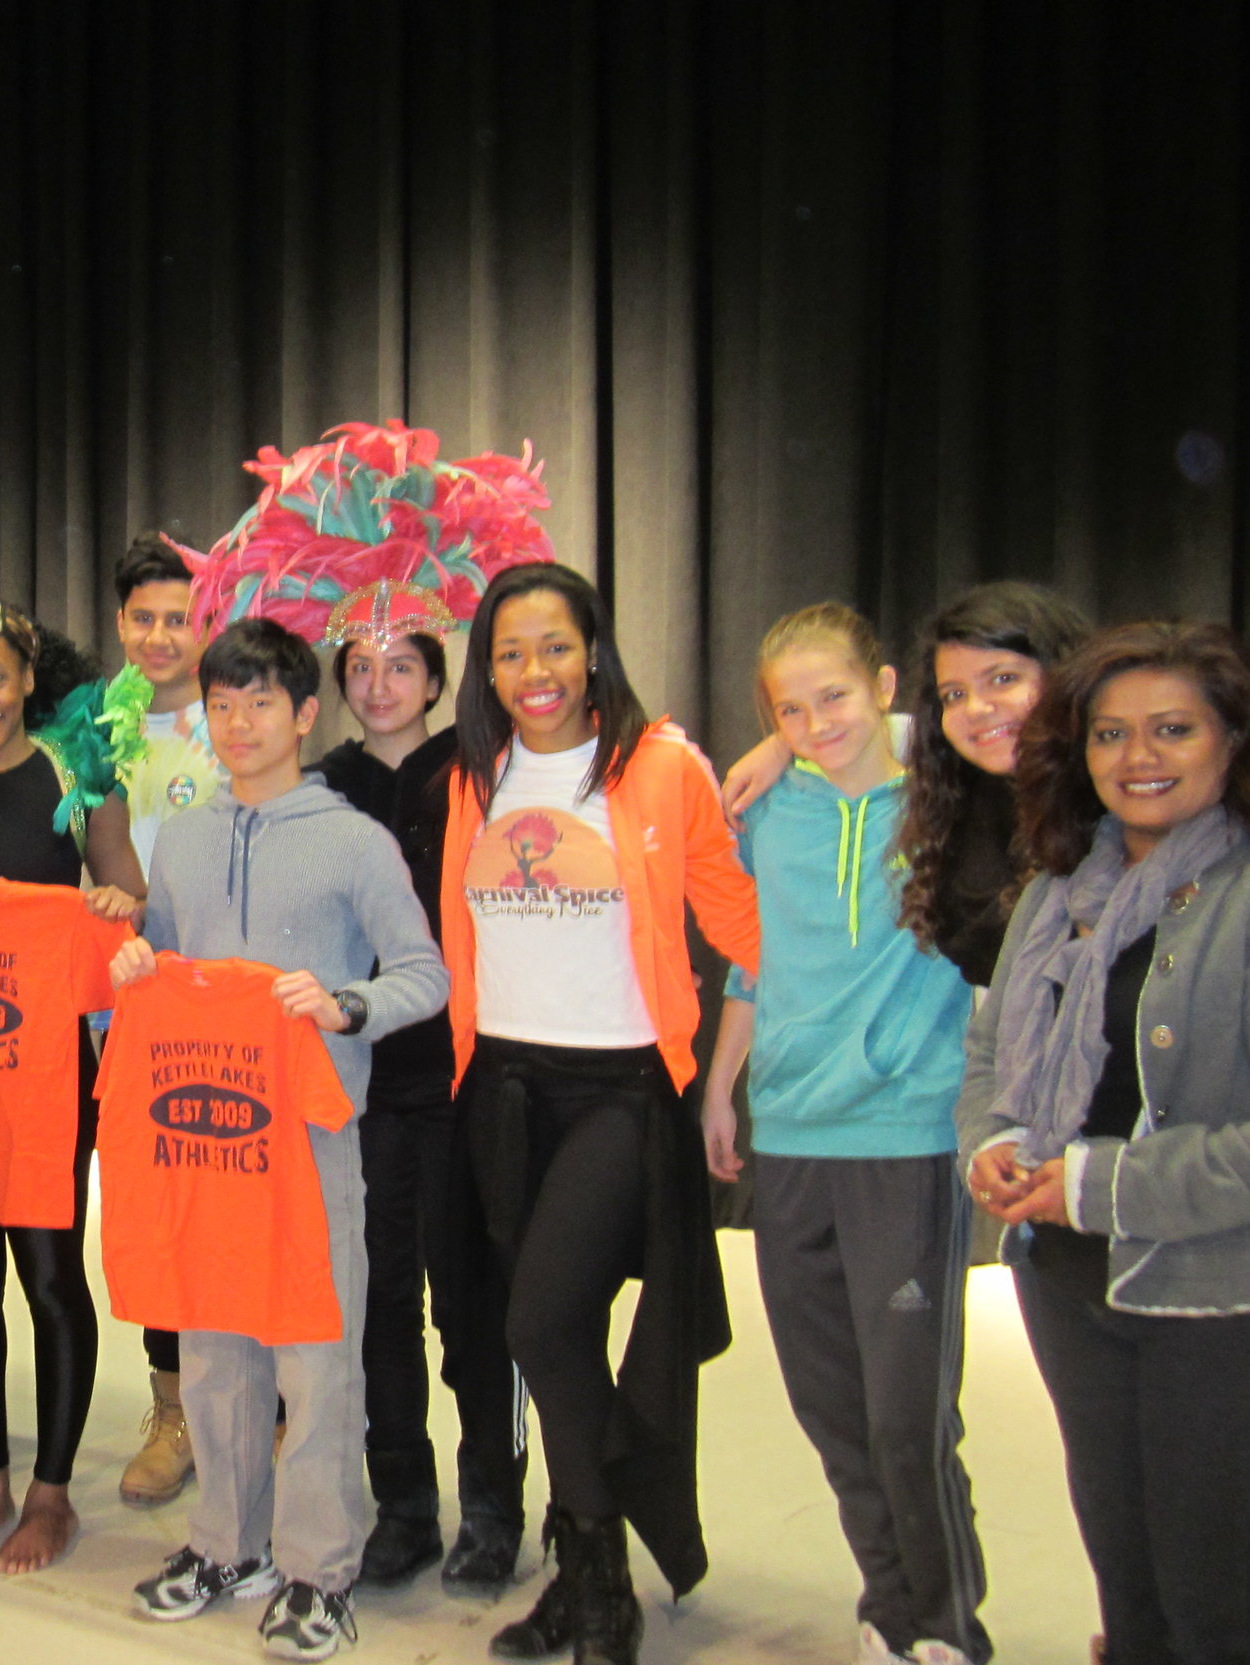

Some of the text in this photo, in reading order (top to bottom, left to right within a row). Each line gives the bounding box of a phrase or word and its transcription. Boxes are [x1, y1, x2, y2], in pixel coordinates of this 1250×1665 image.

[466, 884, 624, 906] arnival Spice
[476, 901, 556, 921] Everything
[150, 1039, 263, 1065] PROPERTY OF
[167, 1098, 203, 1124] EST
